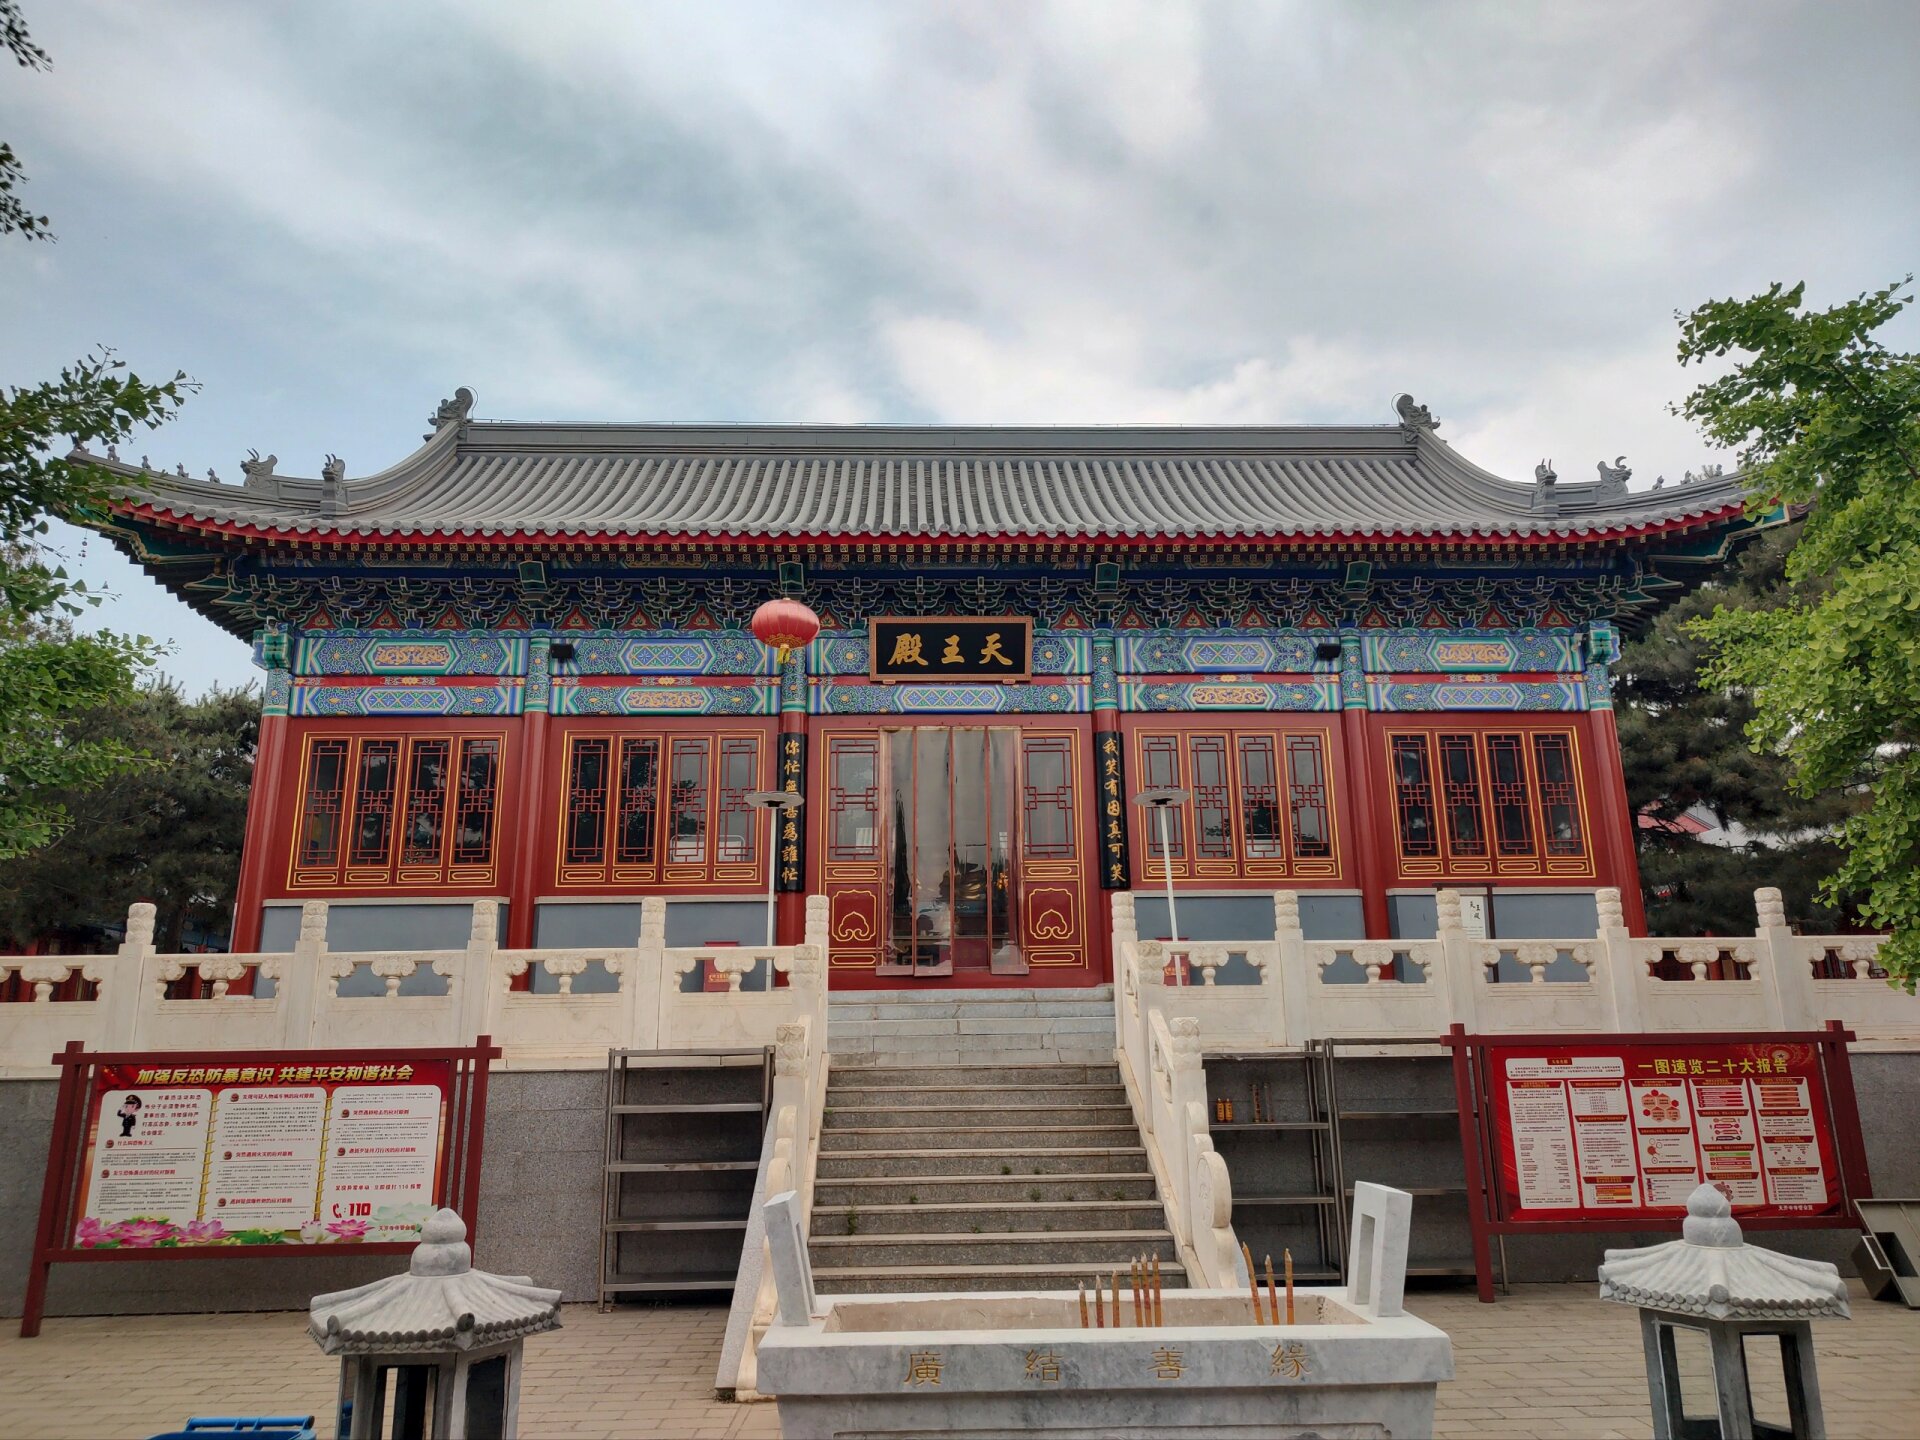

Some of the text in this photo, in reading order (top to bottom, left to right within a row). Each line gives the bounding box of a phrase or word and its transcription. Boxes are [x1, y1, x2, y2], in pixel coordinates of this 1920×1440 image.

[134, 1064, 413, 1085] 加强反恐防暴意识 共建平安和谐社会
[1637, 1057, 1788, 1075] 一图速览二十大报告
[903, 1343, 1313, 1387] 廣結善緣
